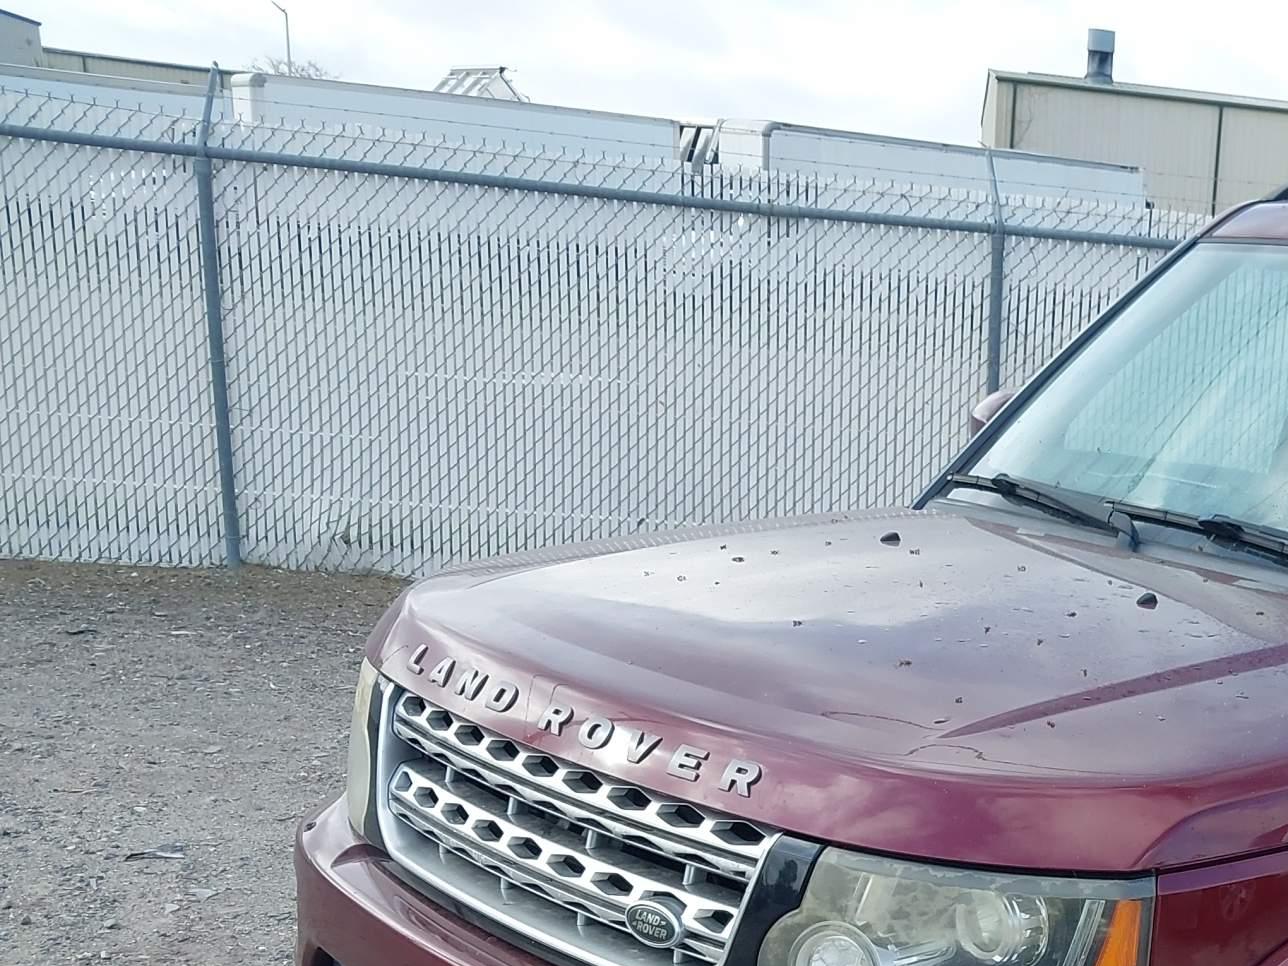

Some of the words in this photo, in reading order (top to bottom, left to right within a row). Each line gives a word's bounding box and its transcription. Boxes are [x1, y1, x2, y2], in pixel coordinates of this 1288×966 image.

[407, 644, 519, 713] LAND
[537, 701, 764, 799] ROVER
[635, 909, 661, 926] LAND
[636, 921, 668, 940] ROVER
